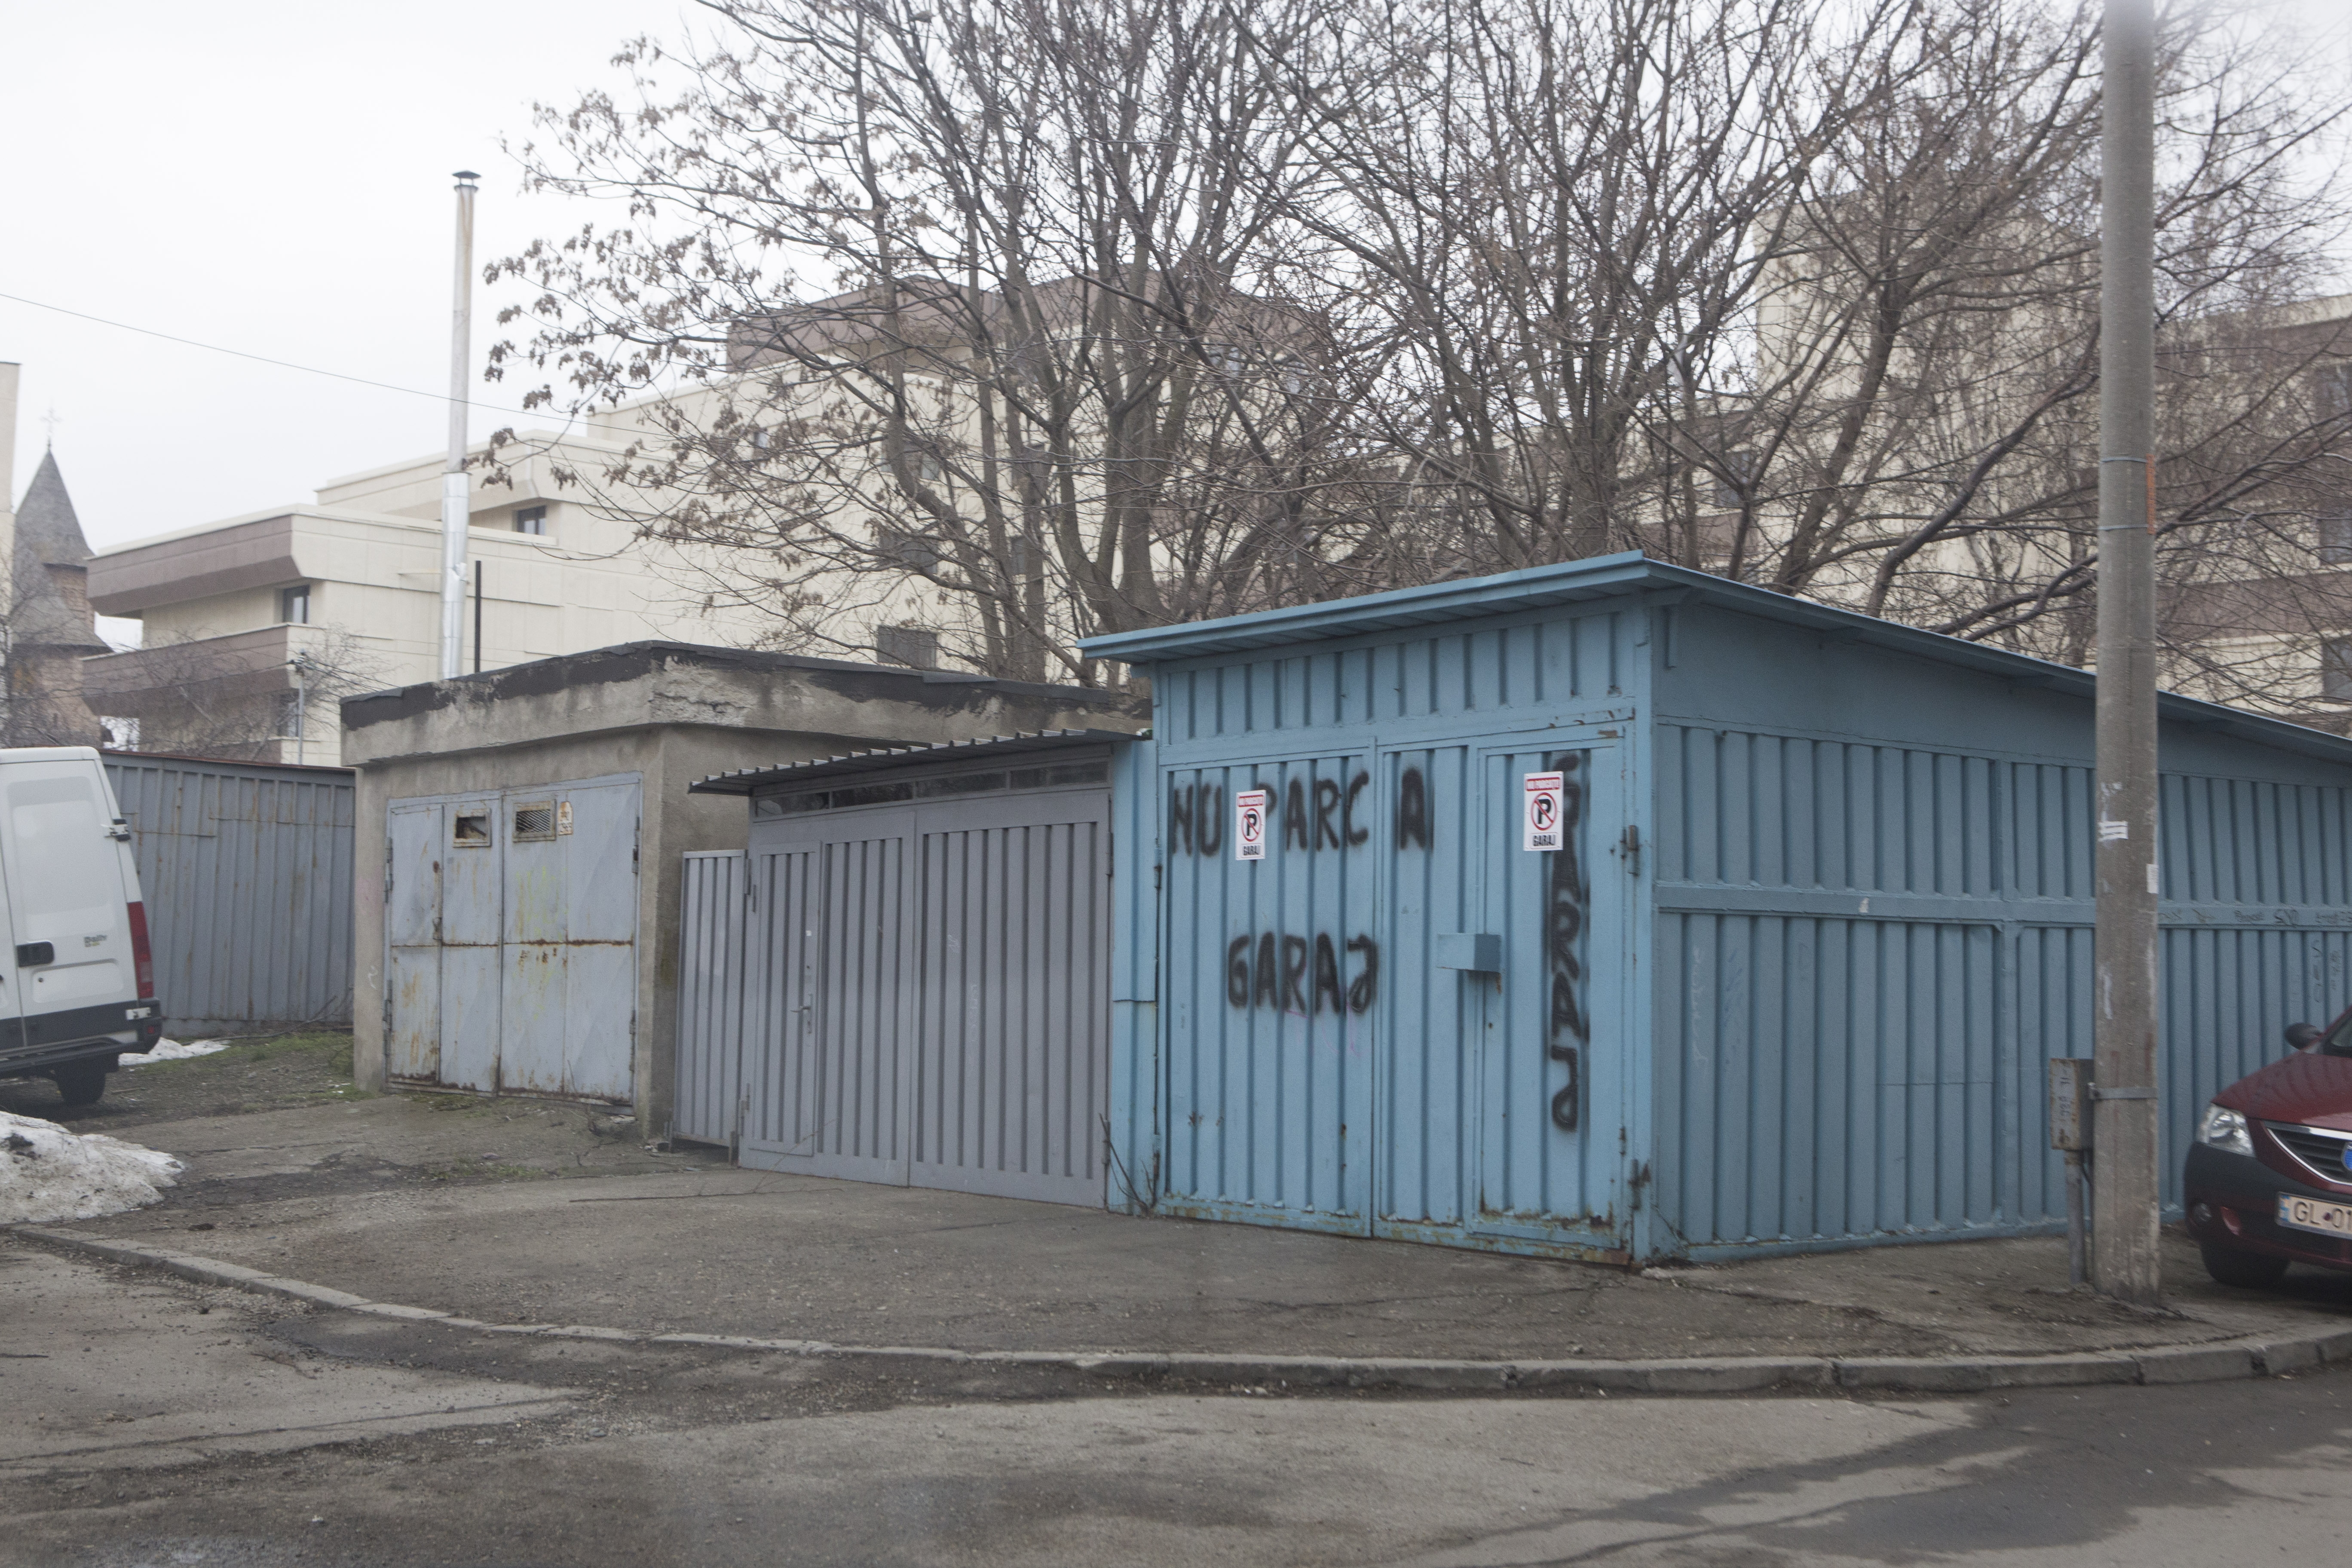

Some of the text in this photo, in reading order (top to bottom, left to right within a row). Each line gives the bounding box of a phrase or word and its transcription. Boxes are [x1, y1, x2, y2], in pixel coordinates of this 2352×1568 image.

[1171, 782, 1223, 857] NU
[1533, 834, 1556, 847] GARAJ
[1243, 845, 1261, 855] GARAJ
[2294, 1201, 2321, 1225] GL
